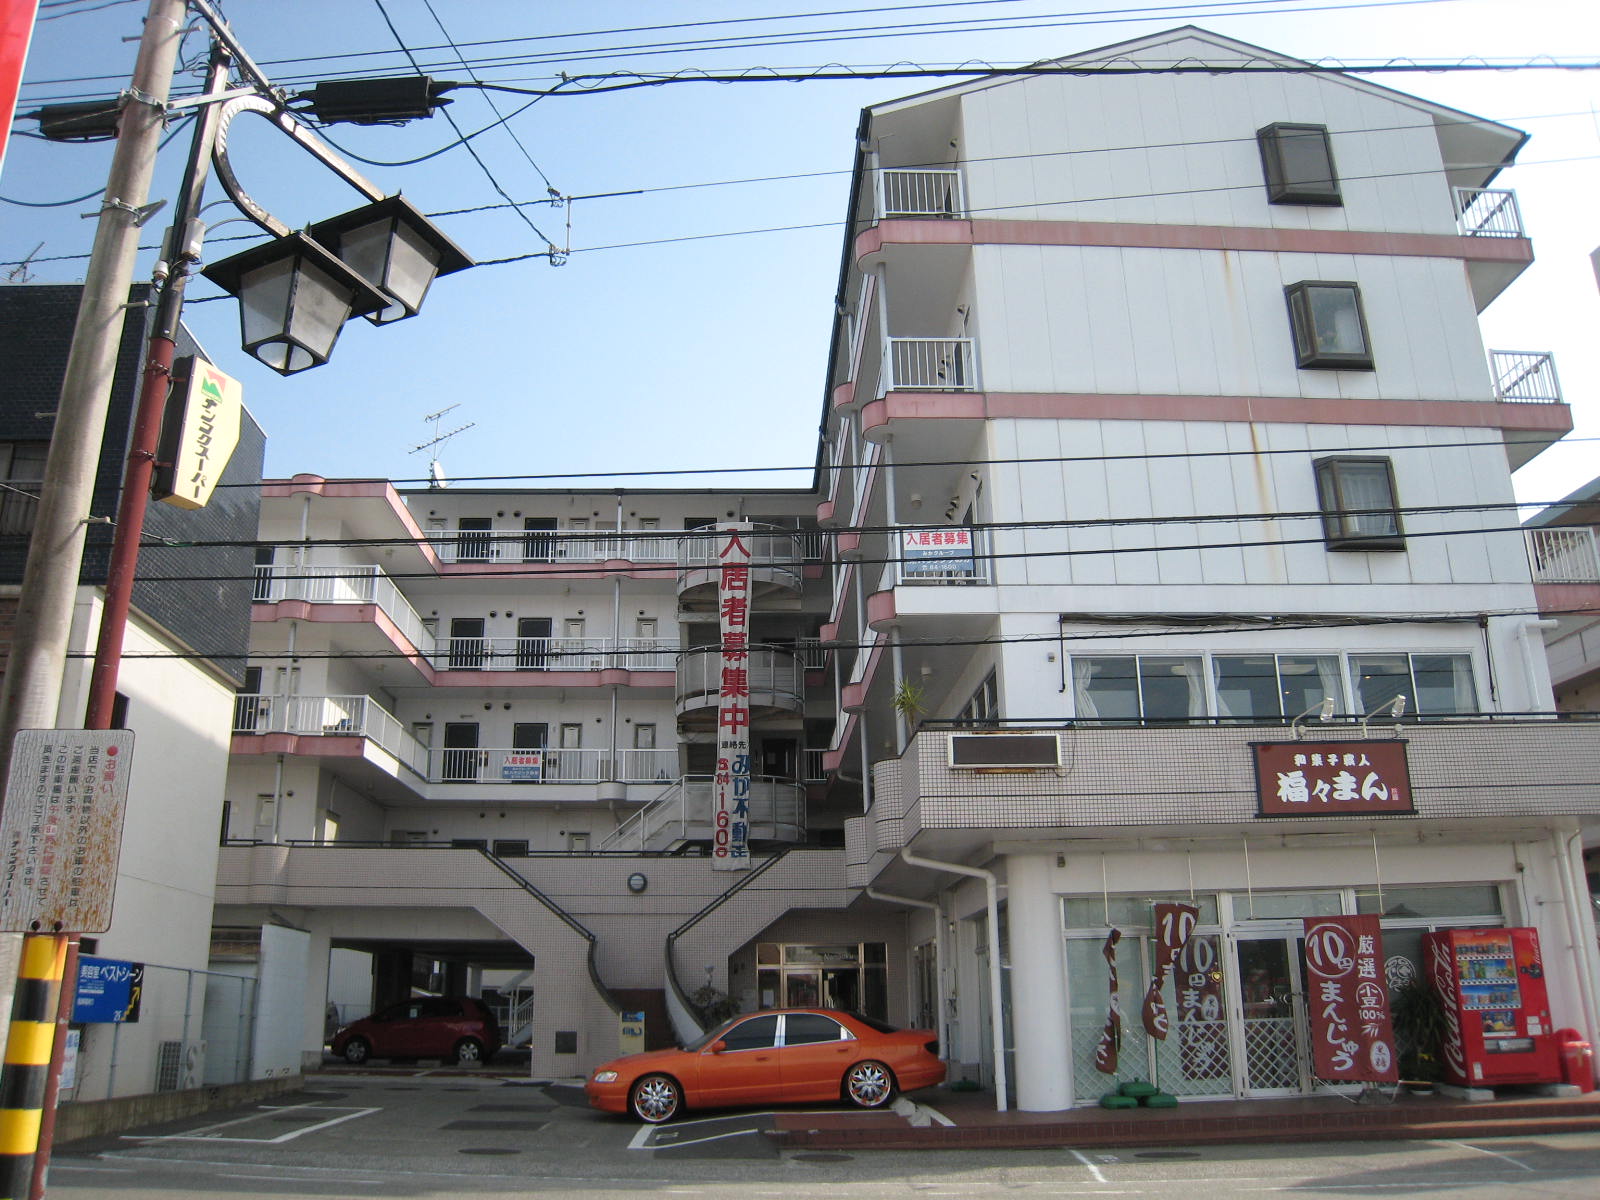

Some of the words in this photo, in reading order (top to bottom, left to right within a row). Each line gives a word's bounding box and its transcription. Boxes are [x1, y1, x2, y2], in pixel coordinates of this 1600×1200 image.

[906, 531, 969, 546] 入居者募集
[718, 528, 751, 736] 入居者募集中
[721, 740, 748, 750] 連絡先
[1294, 753, 1371, 767] 和菓子職人
[1276, 770, 1389, 803] 福々まん
[1357, 934, 1377, 979] 厳選
[100, 965, 143, 983] ベストシーン
